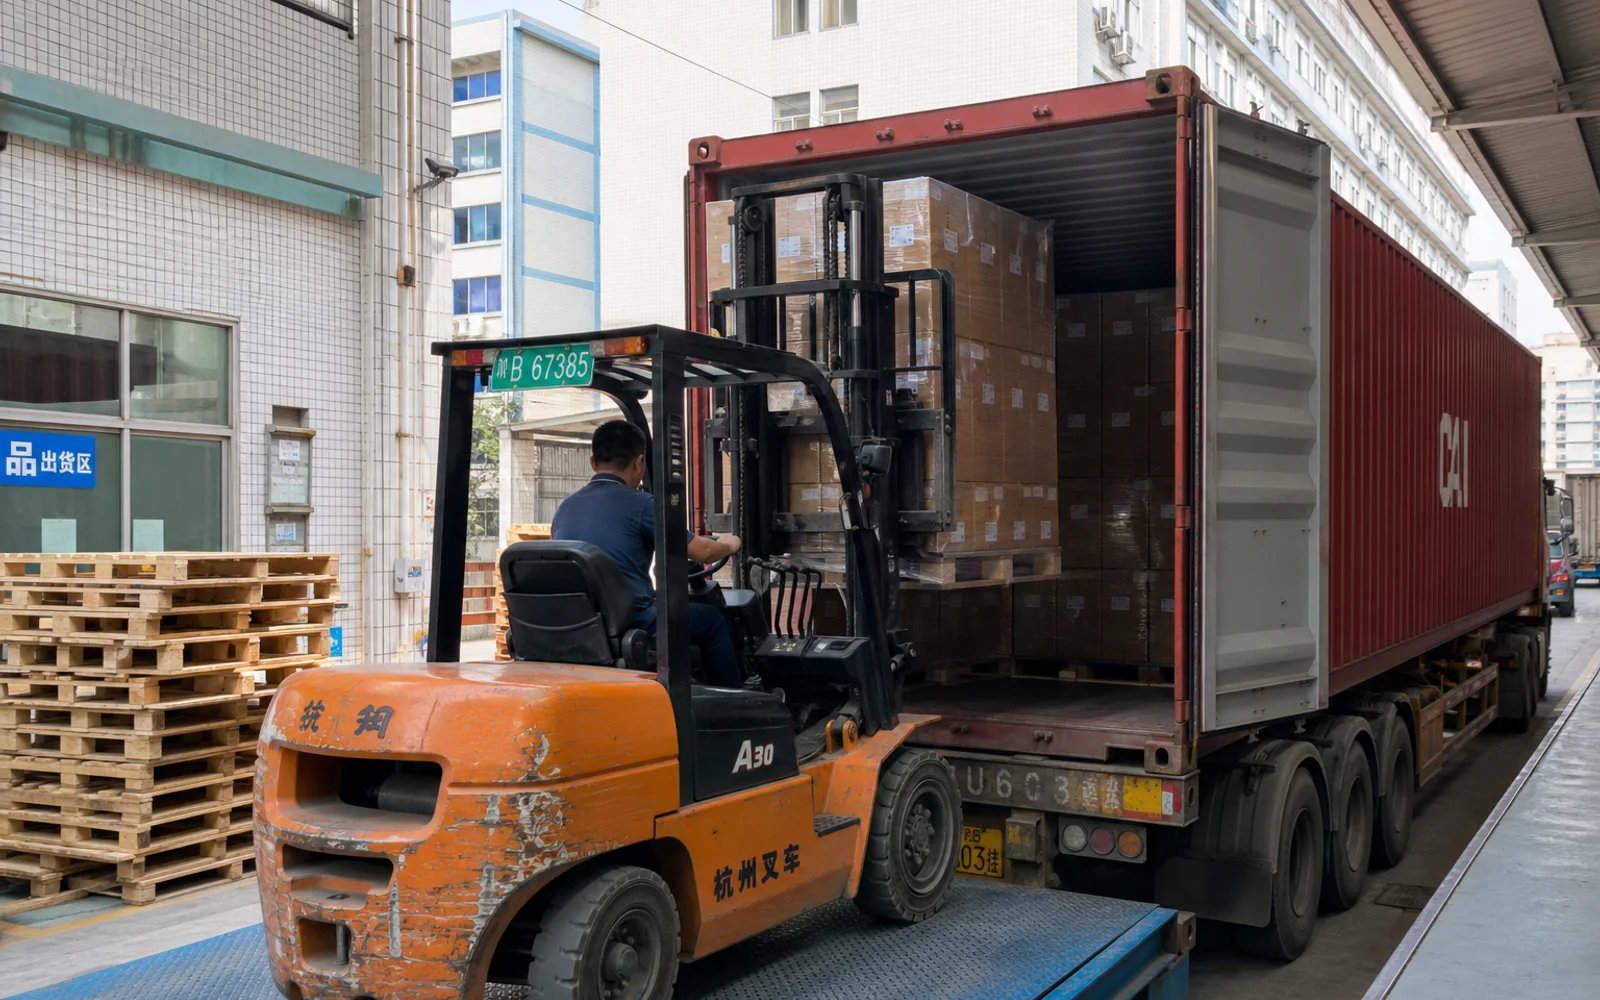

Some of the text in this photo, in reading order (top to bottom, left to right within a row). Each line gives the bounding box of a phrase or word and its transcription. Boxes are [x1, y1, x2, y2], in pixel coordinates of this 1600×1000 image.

[531, 351, 589, 380] 67385
[732, 739, 774, 774] A30
[713, 843, 800, 902] 杭州叉车
